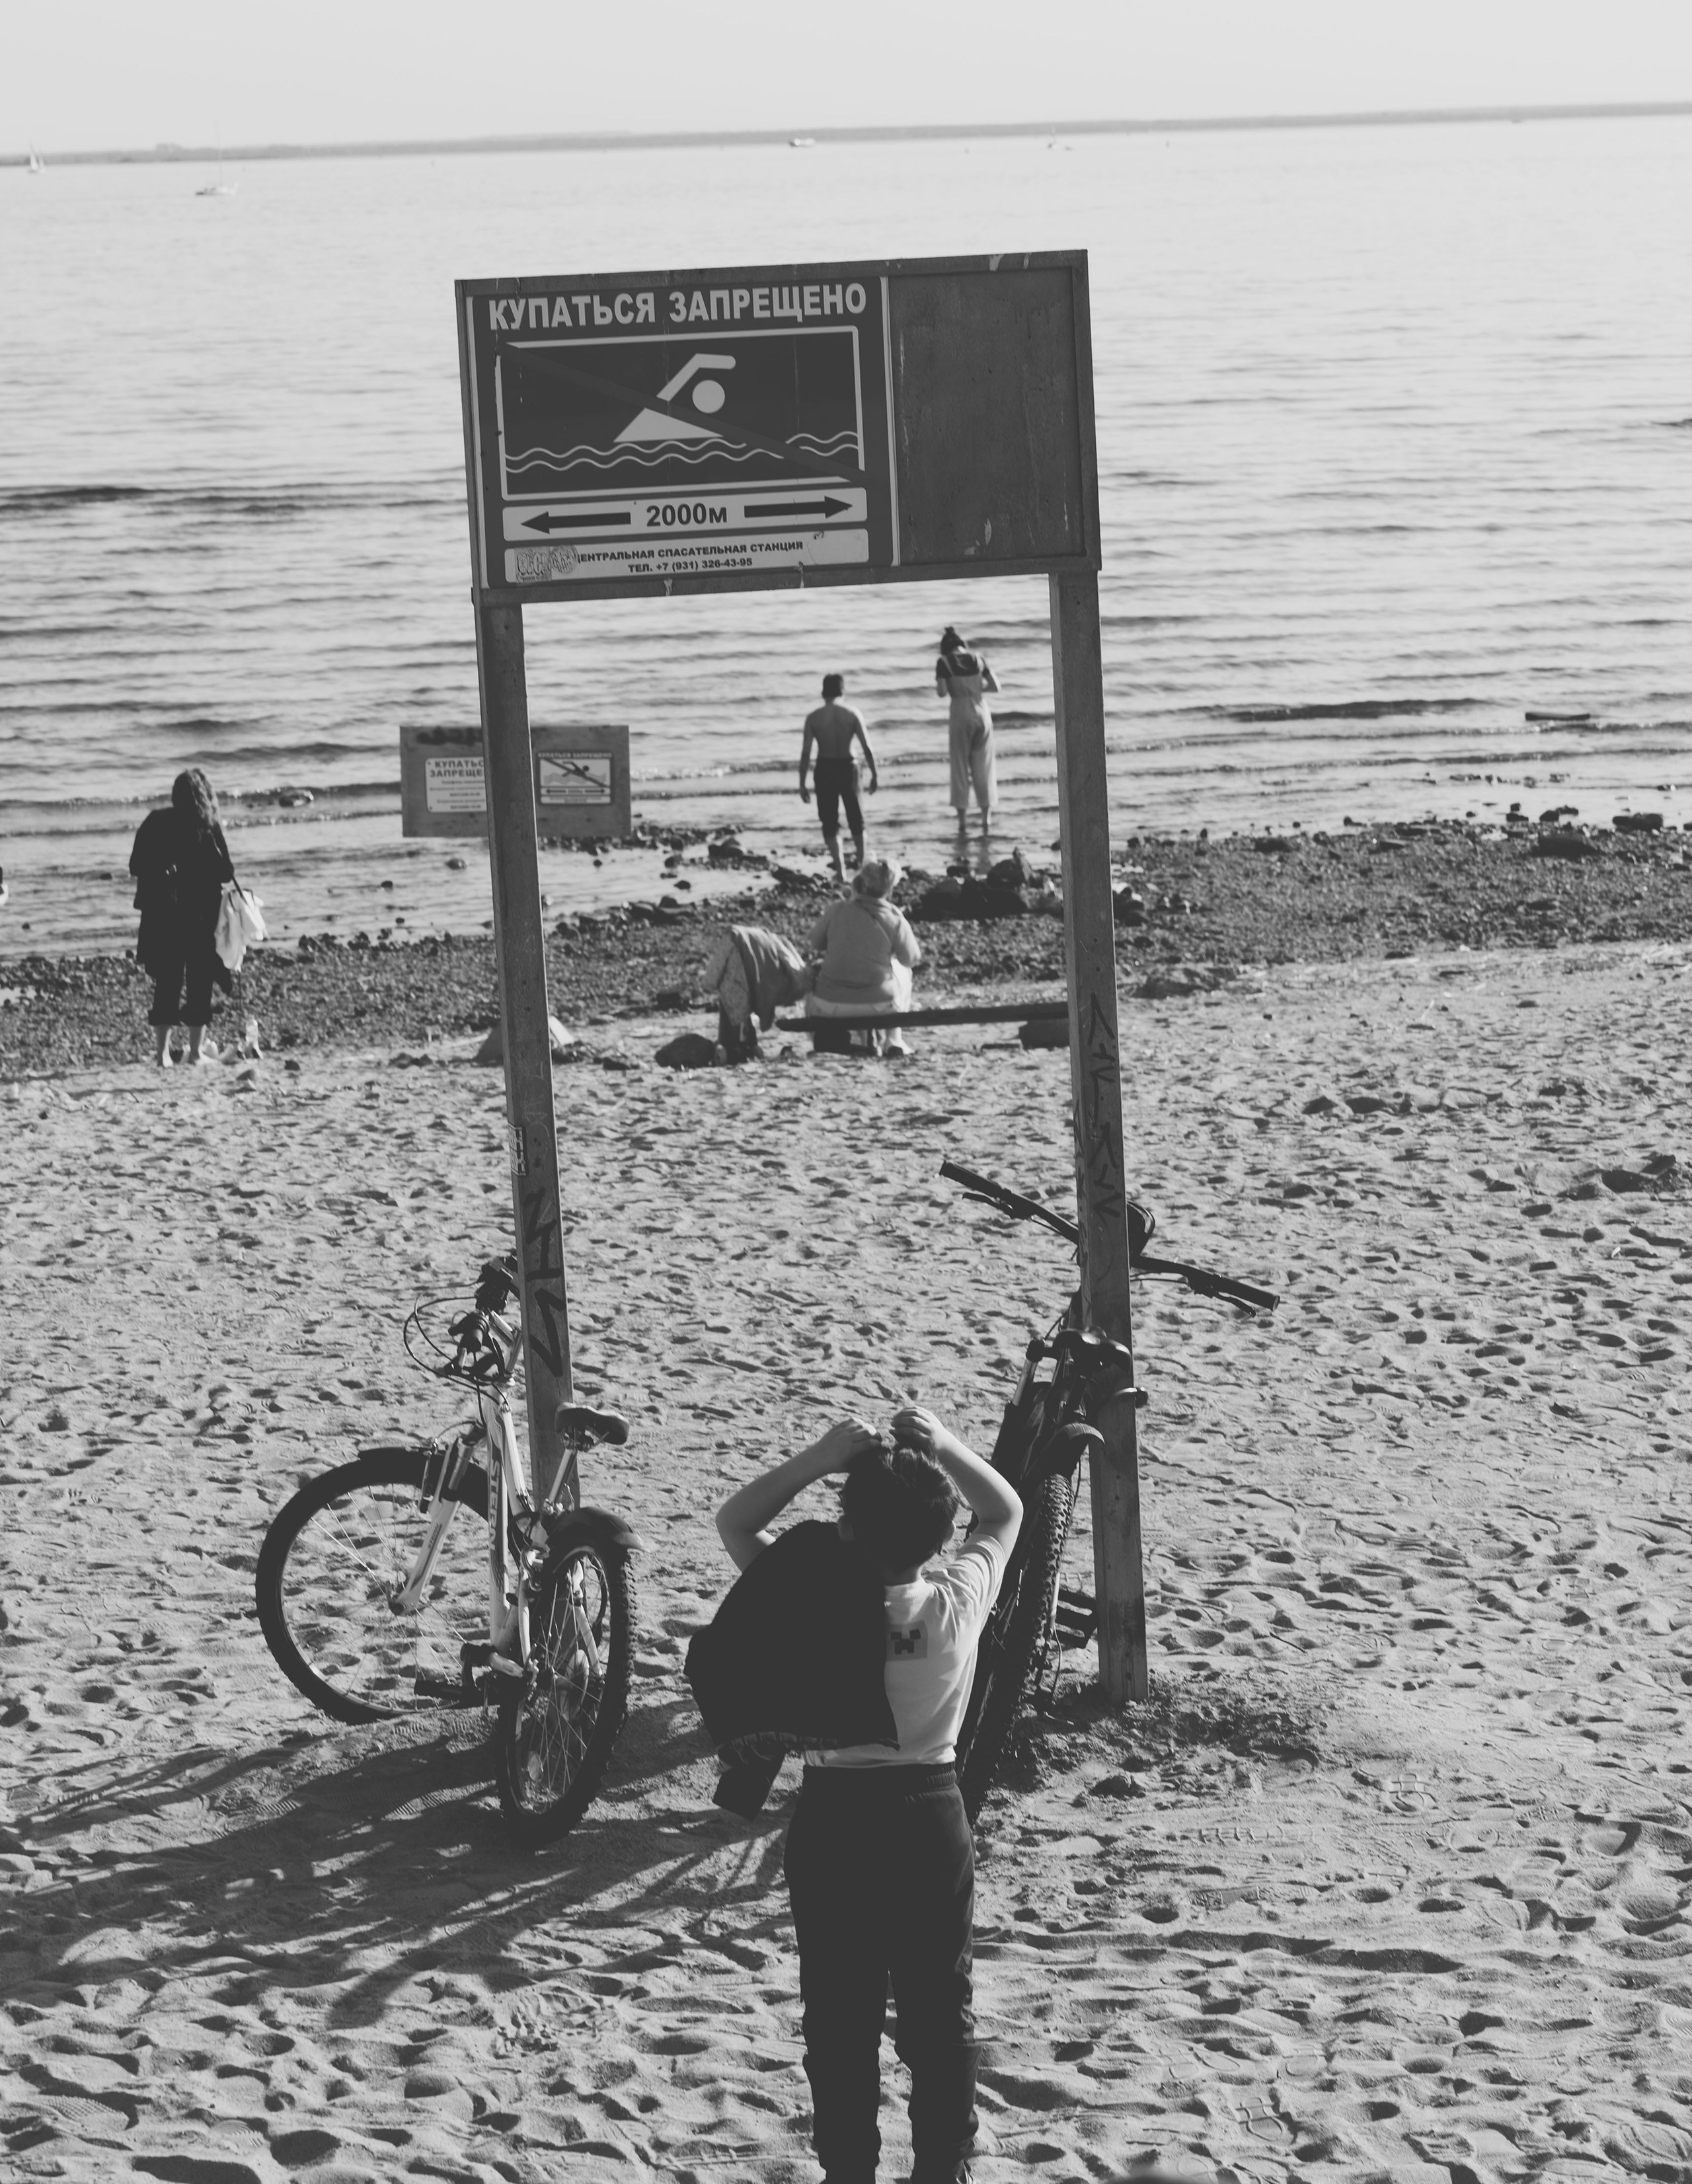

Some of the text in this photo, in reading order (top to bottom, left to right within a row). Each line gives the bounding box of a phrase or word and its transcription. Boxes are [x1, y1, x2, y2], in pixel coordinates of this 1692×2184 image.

[488, 283, 866, 330] КУПАТЬСЯ ЗАПРЕЩЕНО
[646, 503, 727, 527] 2000м
[578, 550, 654, 564] ЕНТРАЛЬНАЯ
[658, 545, 747, 558] СПАСАТЕЛЬНАЯ
[750, 541, 803, 552] СТАНЦИЯ
[628, 564, 653, 573] ТЕЛ.
[656, 562, 669, 571] +7
[672, 560, 699, 572] (931)
[430, 769, 483, 778] ЗАПРЕЩЕ
